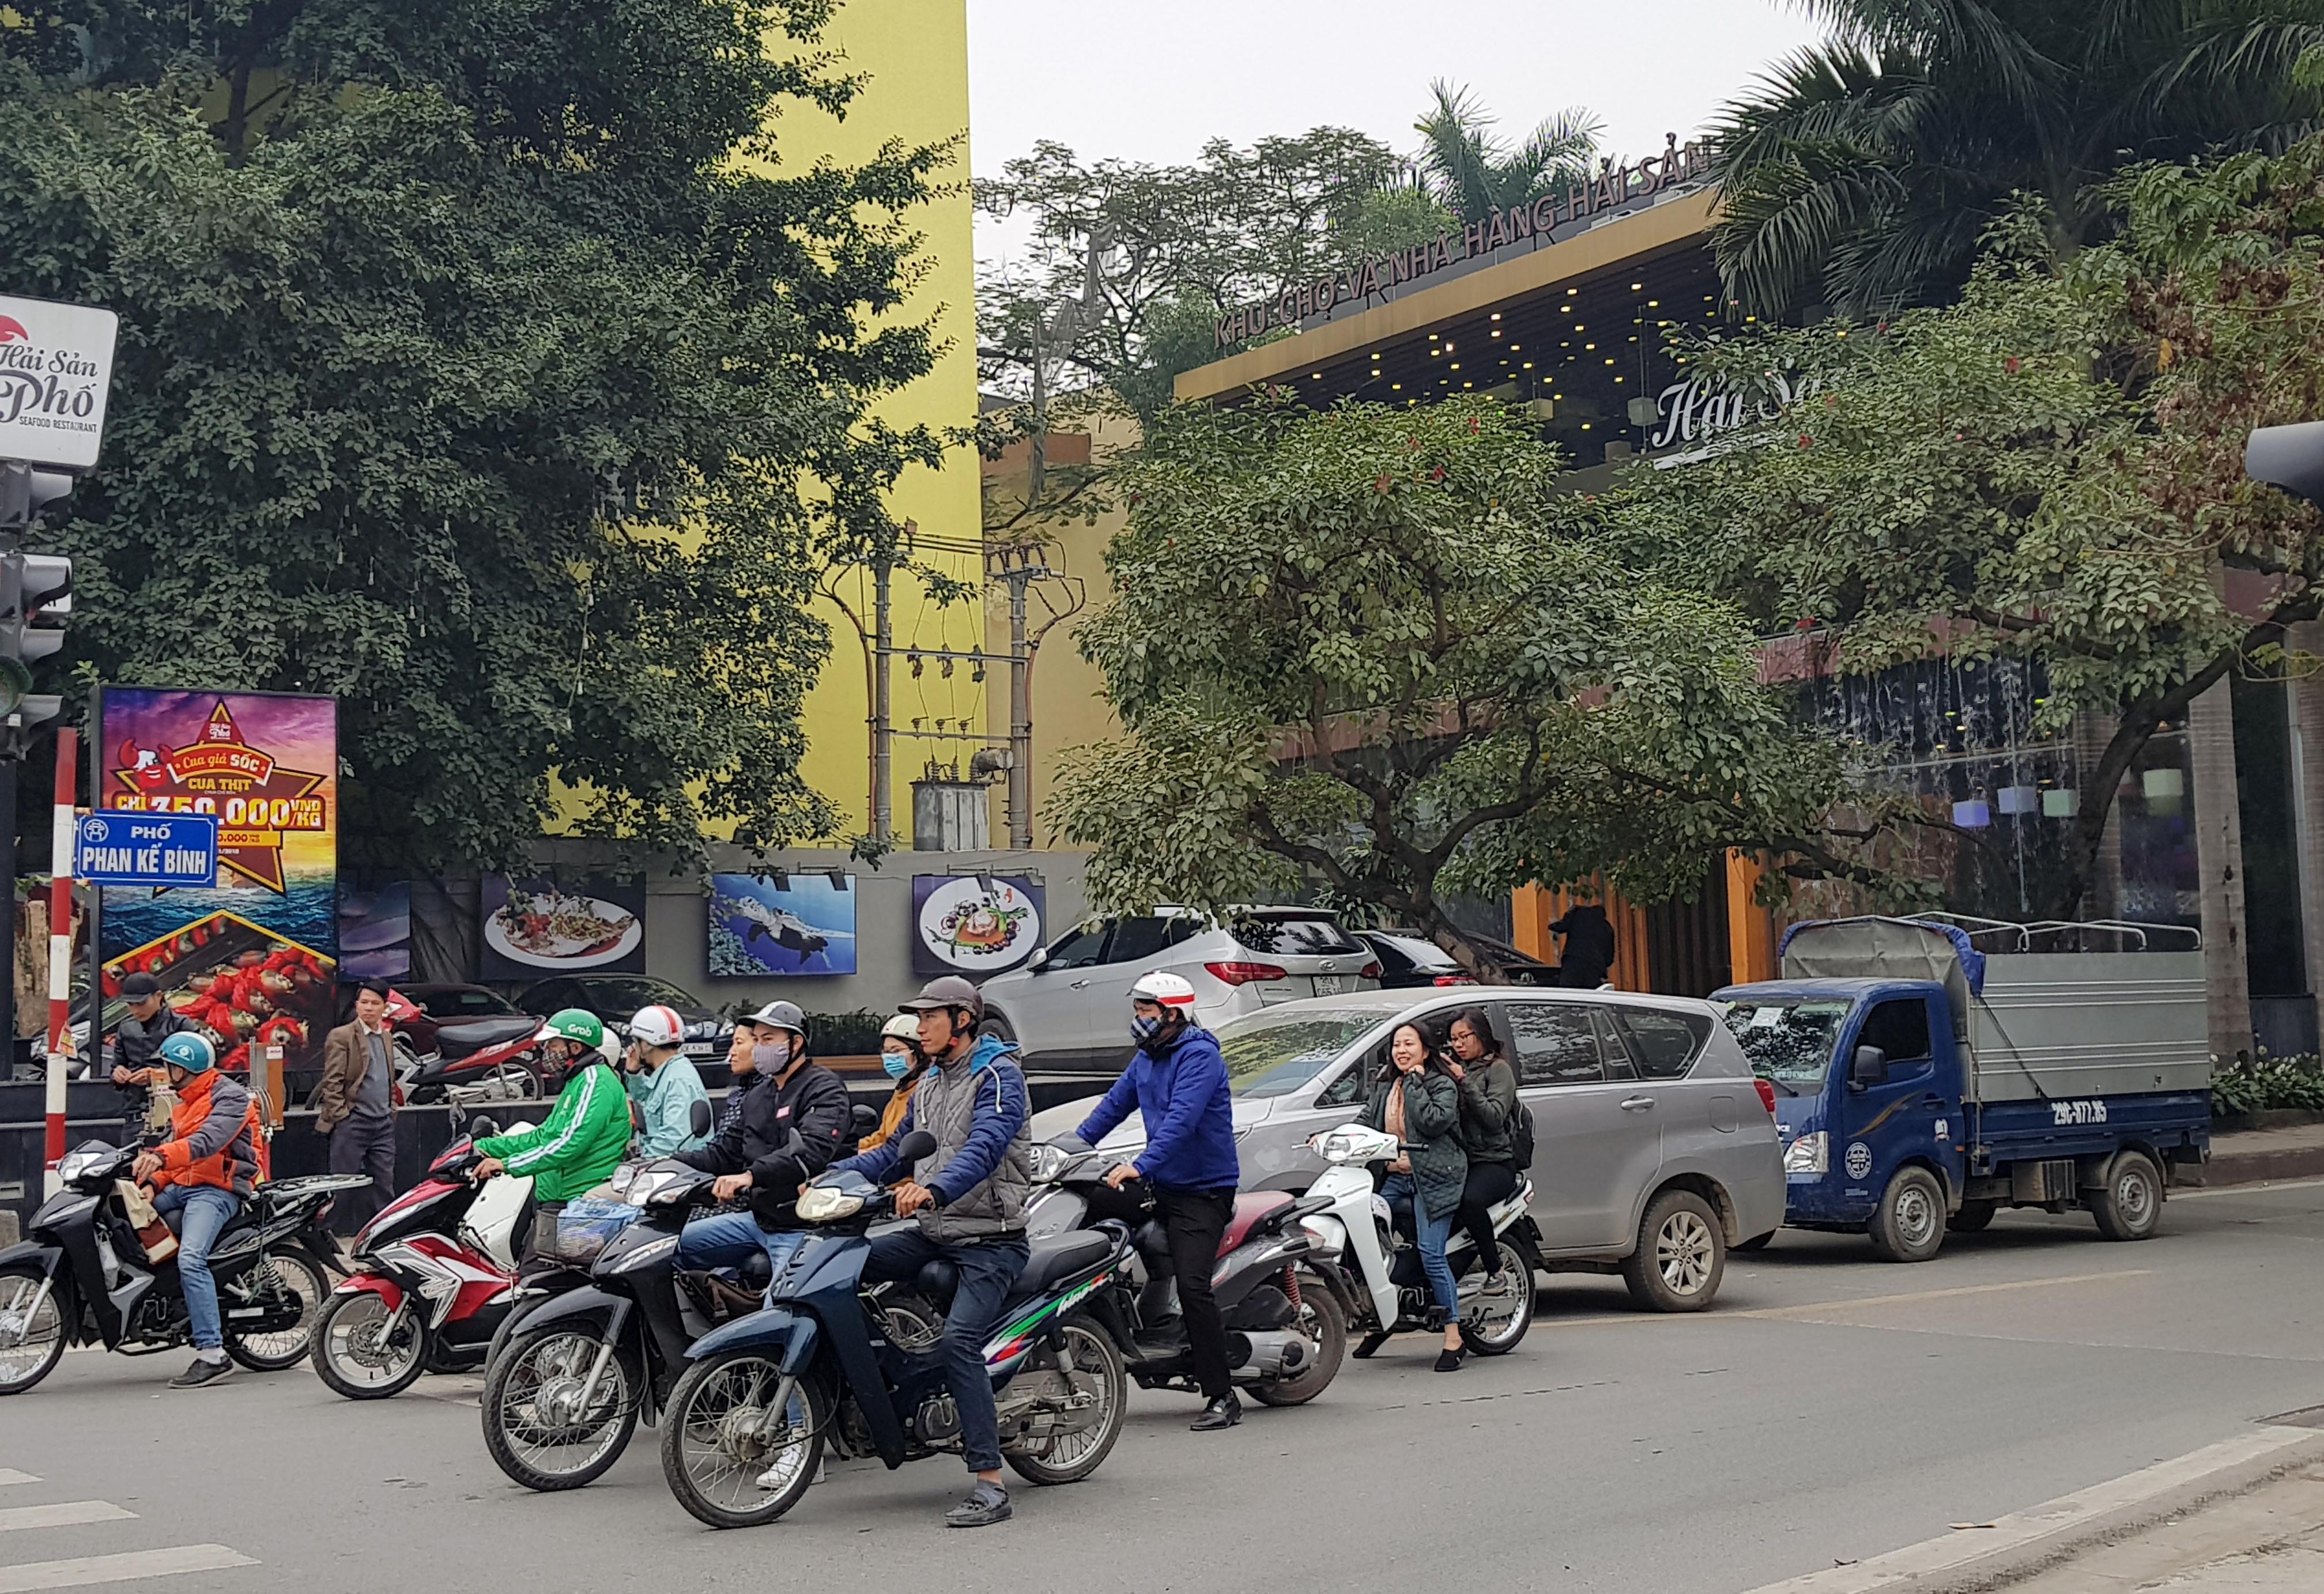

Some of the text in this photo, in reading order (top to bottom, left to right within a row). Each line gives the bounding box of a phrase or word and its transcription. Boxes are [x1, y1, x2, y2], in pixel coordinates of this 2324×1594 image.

[1214, 132, 1712, 346] KHU CHỢ VÀ NHÀ HÀNG HẢI SẢN
[0, 344, 98, 377] Hải Sản
[0, 369, 97, 423] Phố
[19, 416, 97, 433] SEAFOOD RESTAURANT
[183, 753, 259, 772] Cua giá SỐC
[188, 779, 252, 792] CUA THỊT
[131, 822, 172, 840] PHỐ
[82, 843, 207, 874] PHAN KẾ BÍNH
[568, 1023, 592, 1037] Grab
